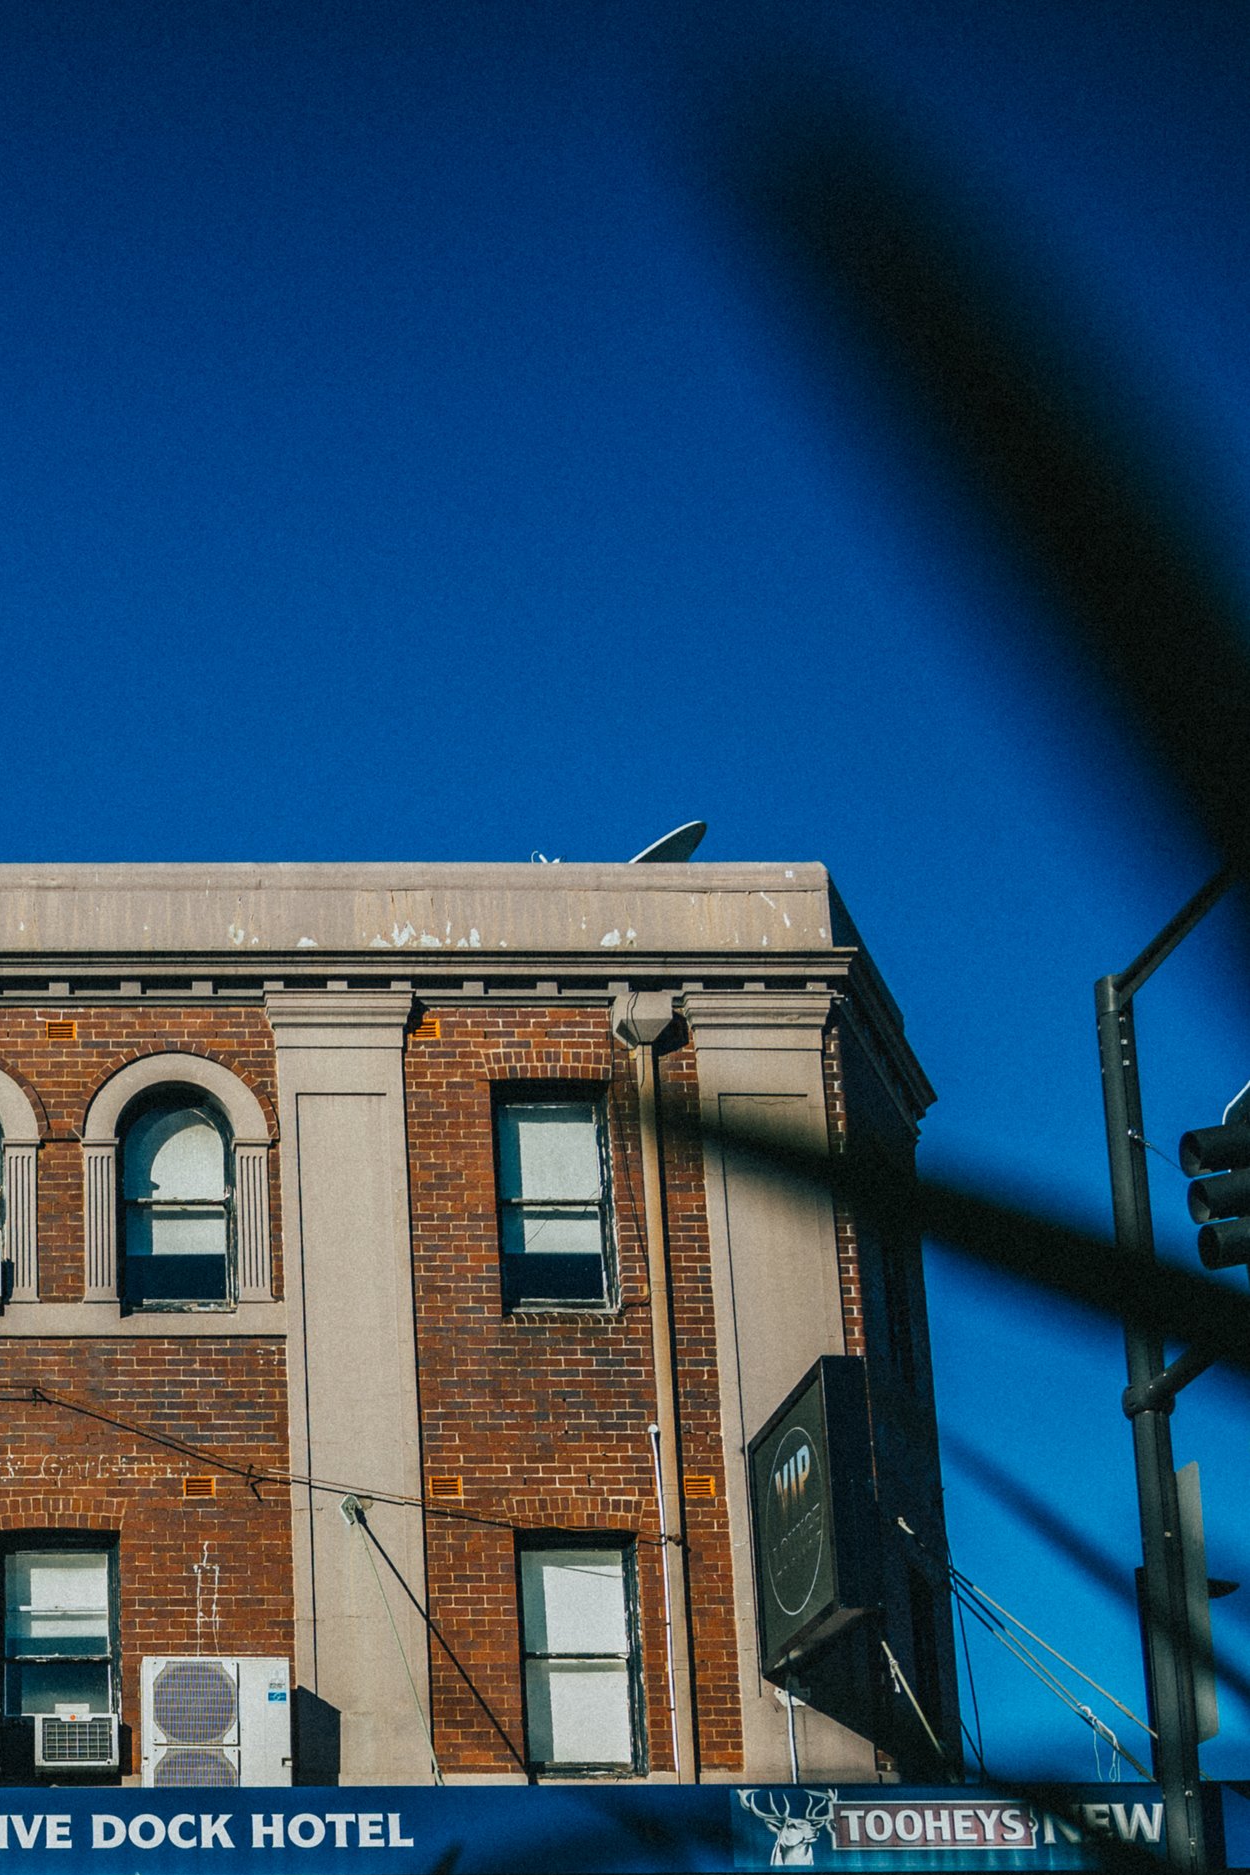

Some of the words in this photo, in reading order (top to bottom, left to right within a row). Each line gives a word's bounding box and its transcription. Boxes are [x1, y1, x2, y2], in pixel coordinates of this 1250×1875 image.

[774, 1444, 810, 1514] VIP
[91, 1813, 236, 1849] DOCK
[251, 1813, 414, 1848] HOTEL
[839, 1808, 1025, 1843] TOOHEYS
